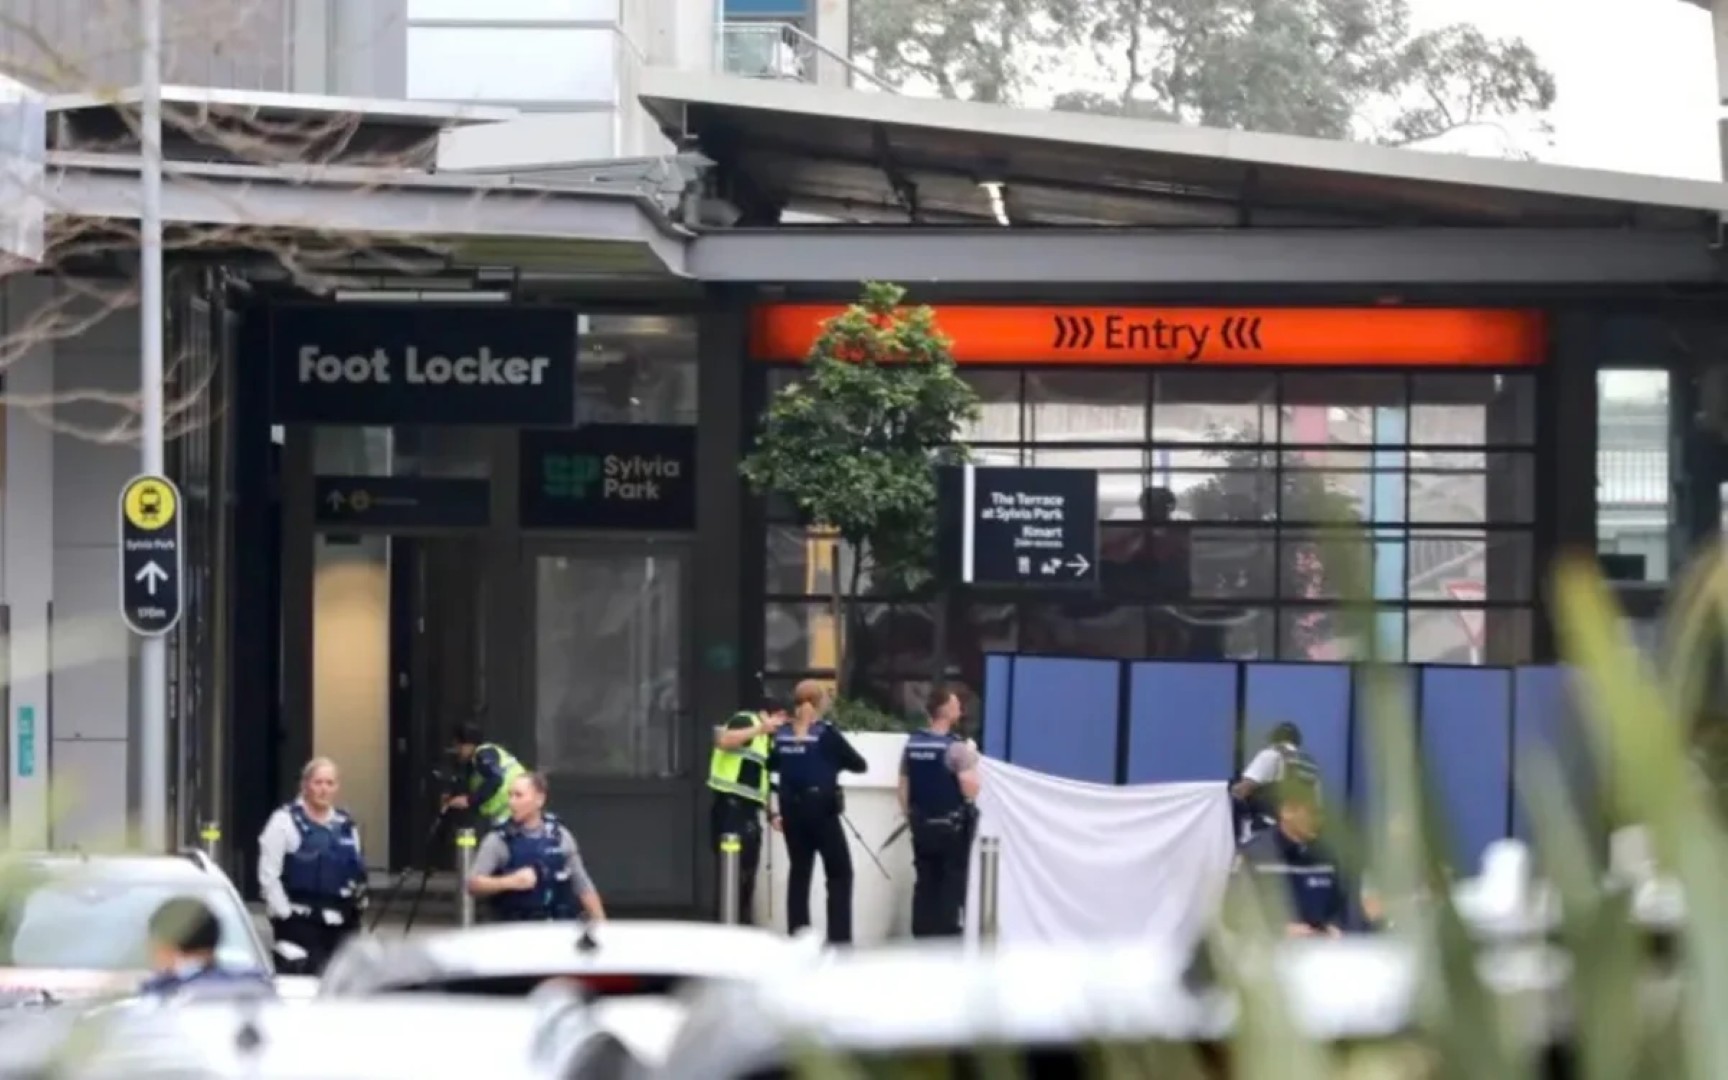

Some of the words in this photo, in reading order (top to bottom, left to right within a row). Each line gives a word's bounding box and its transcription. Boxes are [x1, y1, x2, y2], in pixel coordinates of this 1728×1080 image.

[1105, 315, 1210, 361] Entry
[299, 346, 391, 383] Foot
[405, 346, 549, 384] Locker
[603, 454, 681, 479] Sylvia
[603, 478, 660, 499] Park
[991, 491, 1014, 505] The
[1015, 491, 1064, 506] Terrace
[981, 508, 994, 519] at
[995, 506, 1032, 522] Sylvia
[1033, 507, 1063, 521] Park
